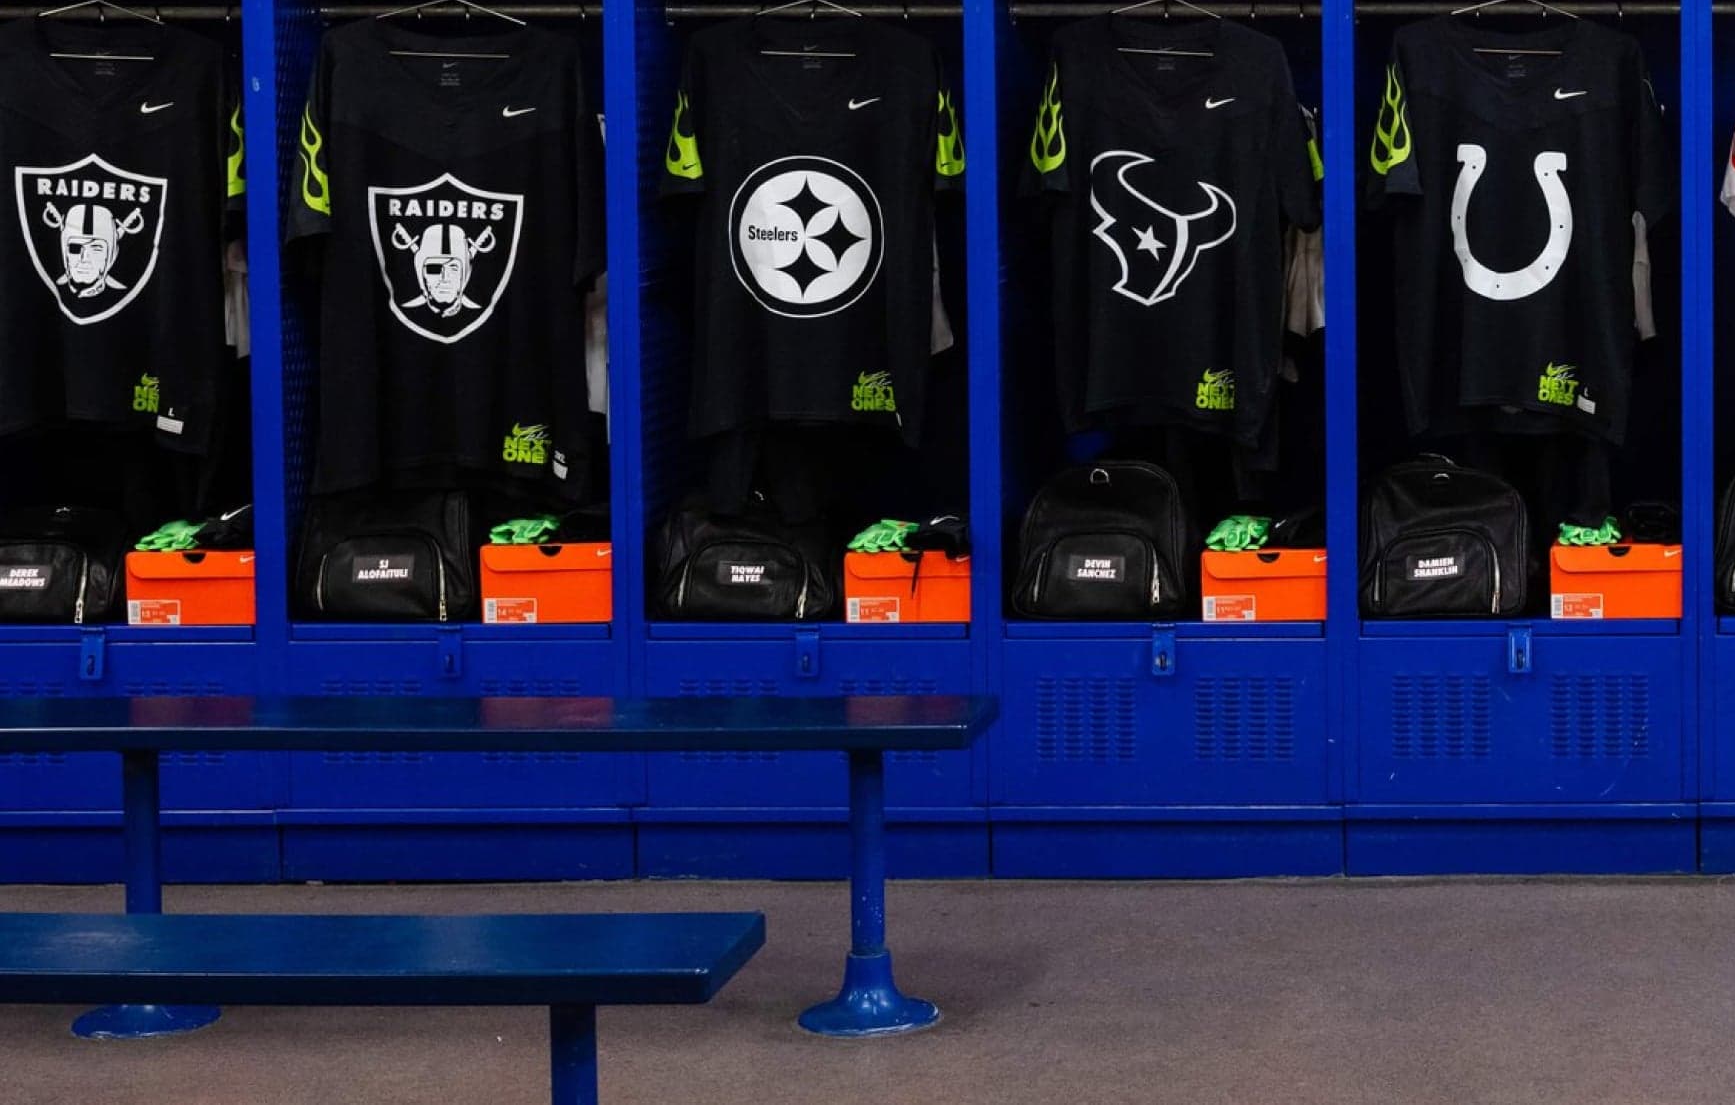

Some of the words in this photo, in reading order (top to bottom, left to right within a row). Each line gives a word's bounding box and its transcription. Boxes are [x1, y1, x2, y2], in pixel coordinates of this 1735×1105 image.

[37, 177, 151, 204] RAIDERS
[388, 198, 505, 221] RAIDERS
[747, 224, 799, 242] Steelers
[1538, 375, 1579, 394] NEXT
[1537, 389, 1575, 407] ONES
[851, 397, 897, 412] ONES
[166, 406, 176, 418] L
[1084, 559, 1111, 569] DEVIN
[1417, 557, 1455, 569] DAMIEN
[9, 568, 39, 578] DEREK
[357, 568, 409, 580] ALOFAITULI
[1076, 568, 1116, 579] SANCHEZ
[1413, 564, 1458, 577] SHANKLIN
[732, 574, 761, 583] HAYES
